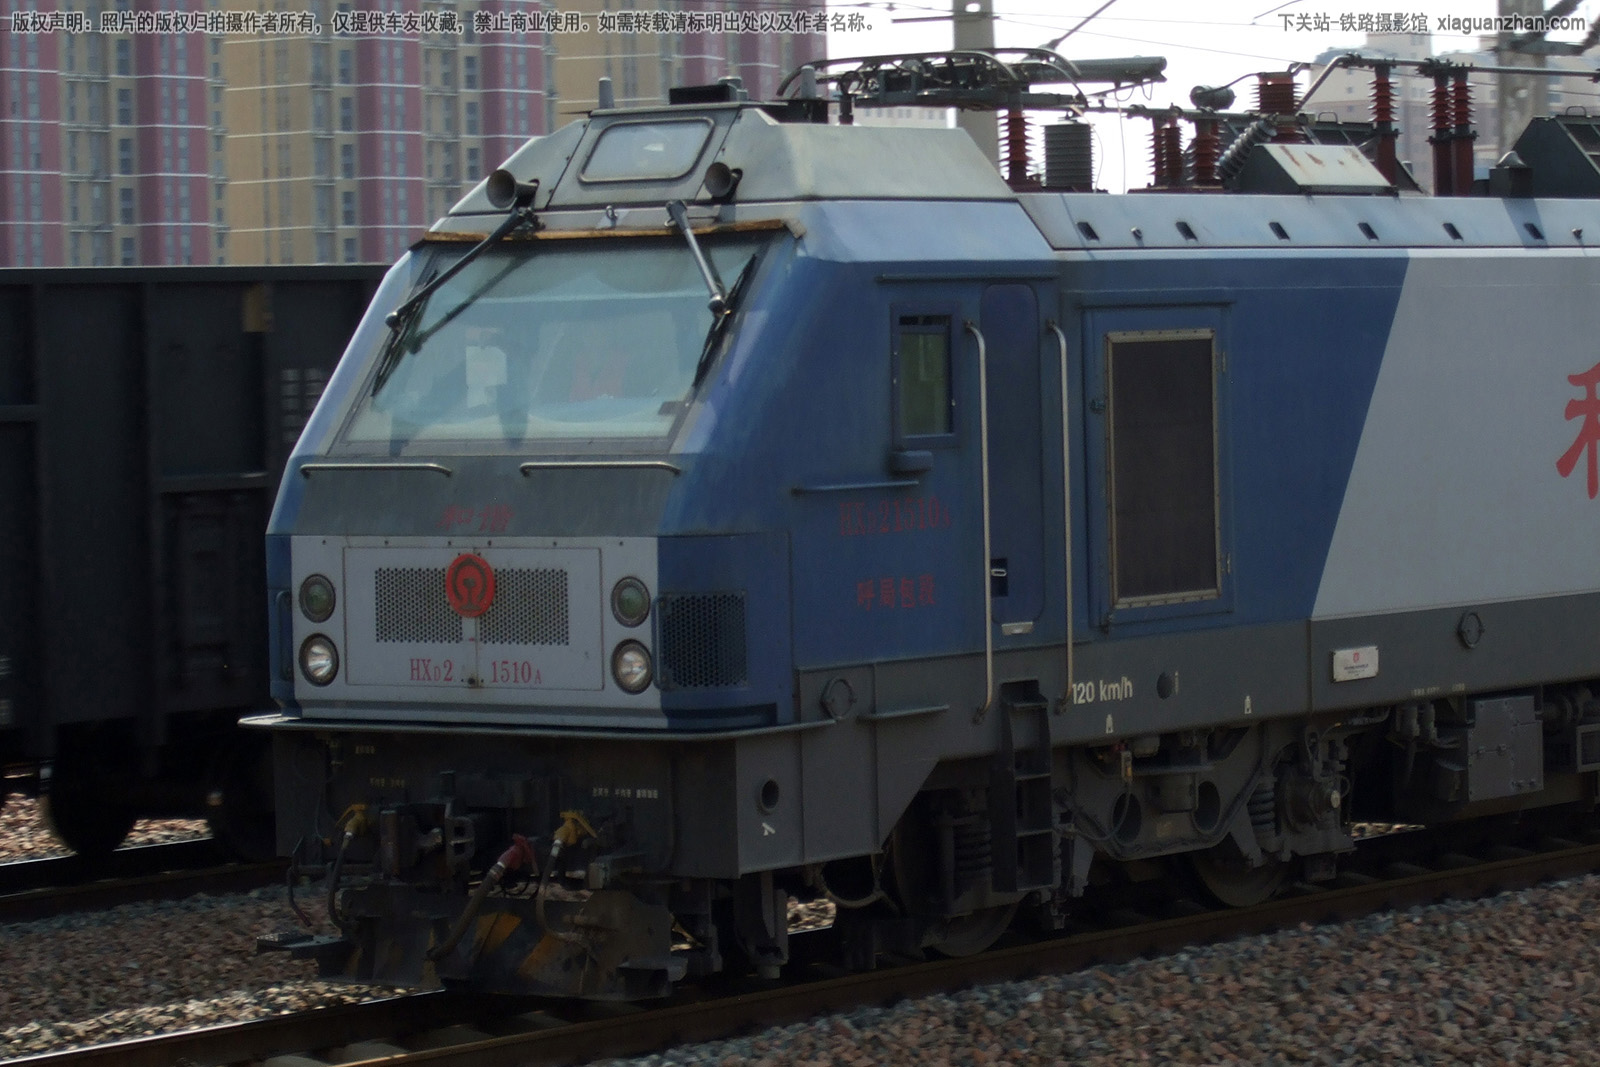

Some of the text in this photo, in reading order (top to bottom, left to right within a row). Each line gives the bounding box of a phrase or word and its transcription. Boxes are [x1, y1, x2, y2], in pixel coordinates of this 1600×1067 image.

[492, 661, 542, 684] 1510A
[1072, 676, 1133, 705] 120 km/h
